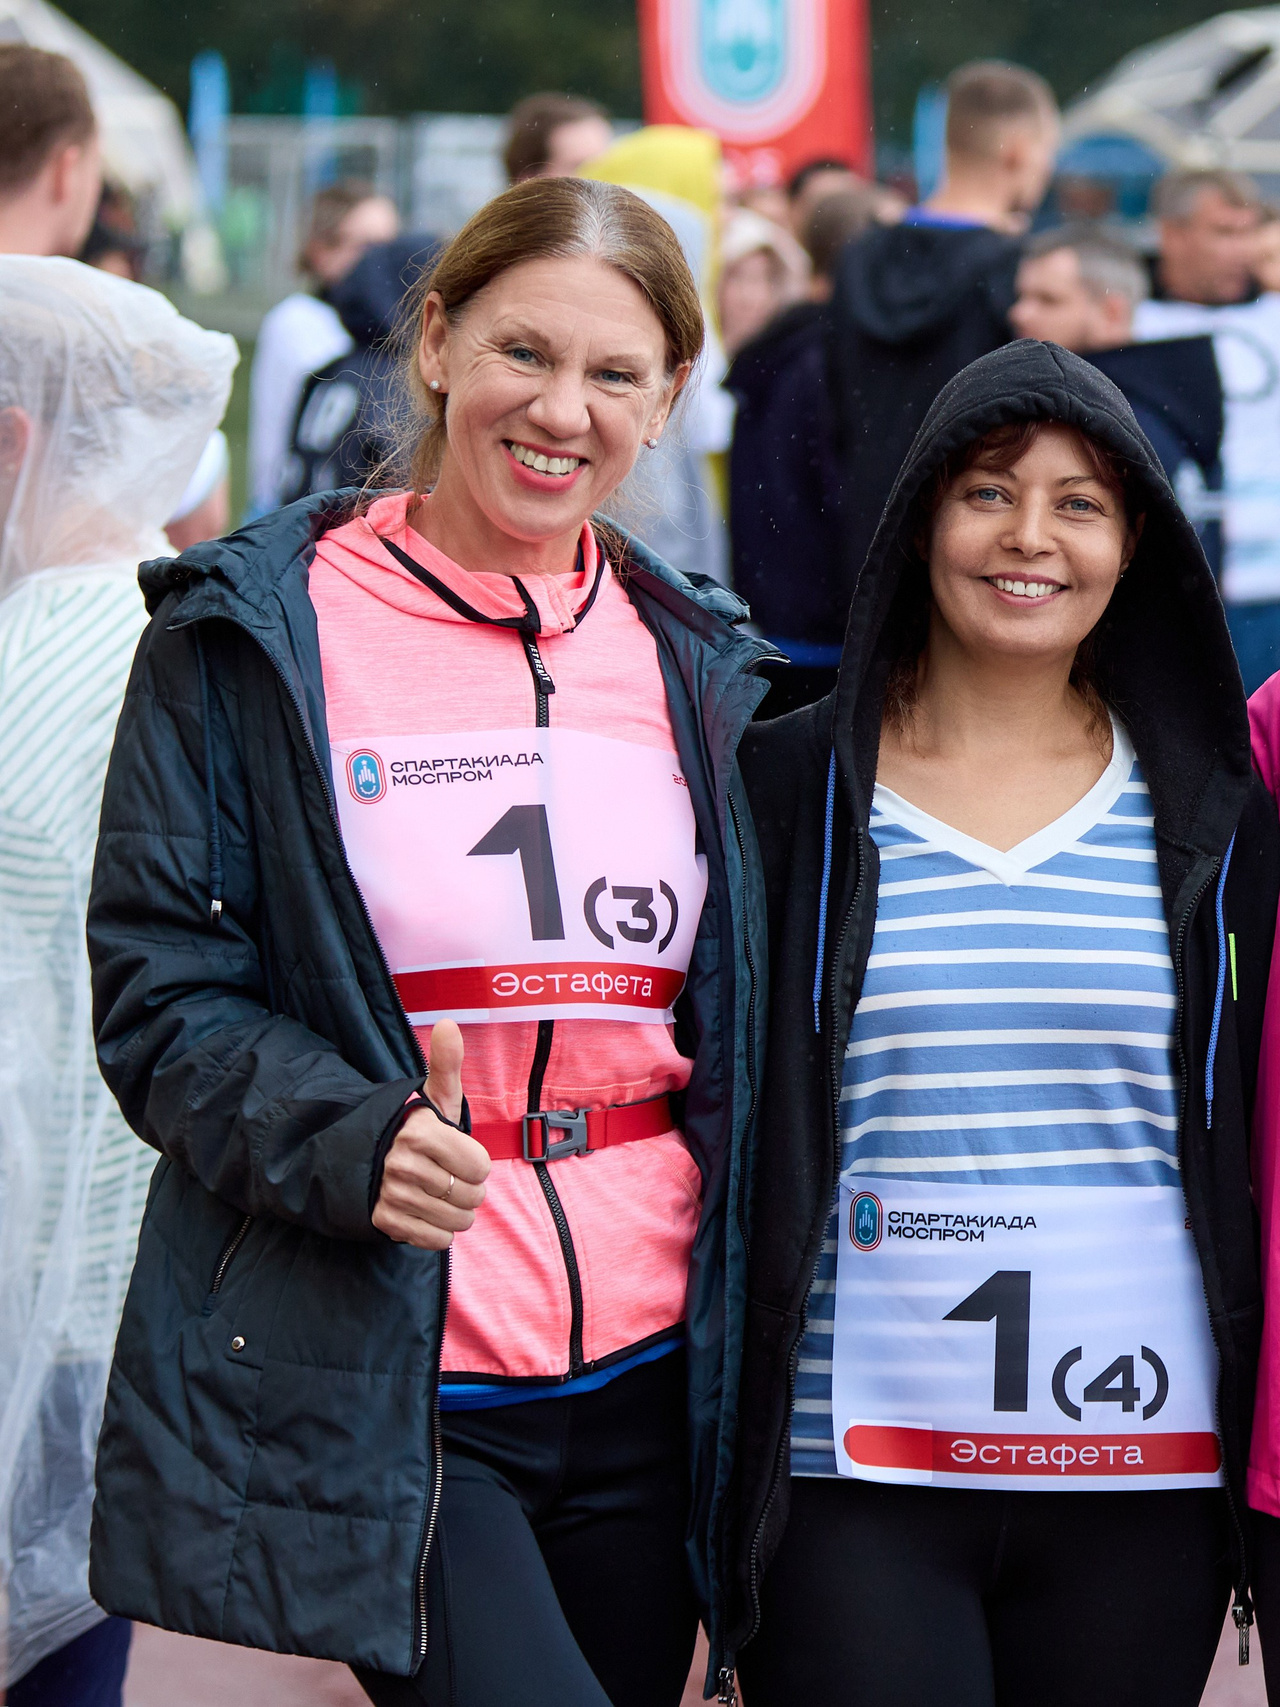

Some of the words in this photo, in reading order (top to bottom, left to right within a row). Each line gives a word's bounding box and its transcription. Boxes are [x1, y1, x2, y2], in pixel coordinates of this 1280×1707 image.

[390, 752, 544, 774] СПАРТАКИАДА
[391, 769, 493, 787] МОСПРОМ
[466, 803, 566, 941] 1
[583, 876, 679, 955] (3)
[491, 971, 653, 1001] Эстафета
[887, 1210, 1037, 1230] СПАРТАКИАДА
[887, 1224, 985, 1242] МОСПРОМ
[941, 1270, 1032, 1413] 1
[1051, 1344, 1169, 1422] (4)
[950, 1438, 1144, 1473] Эстафета
